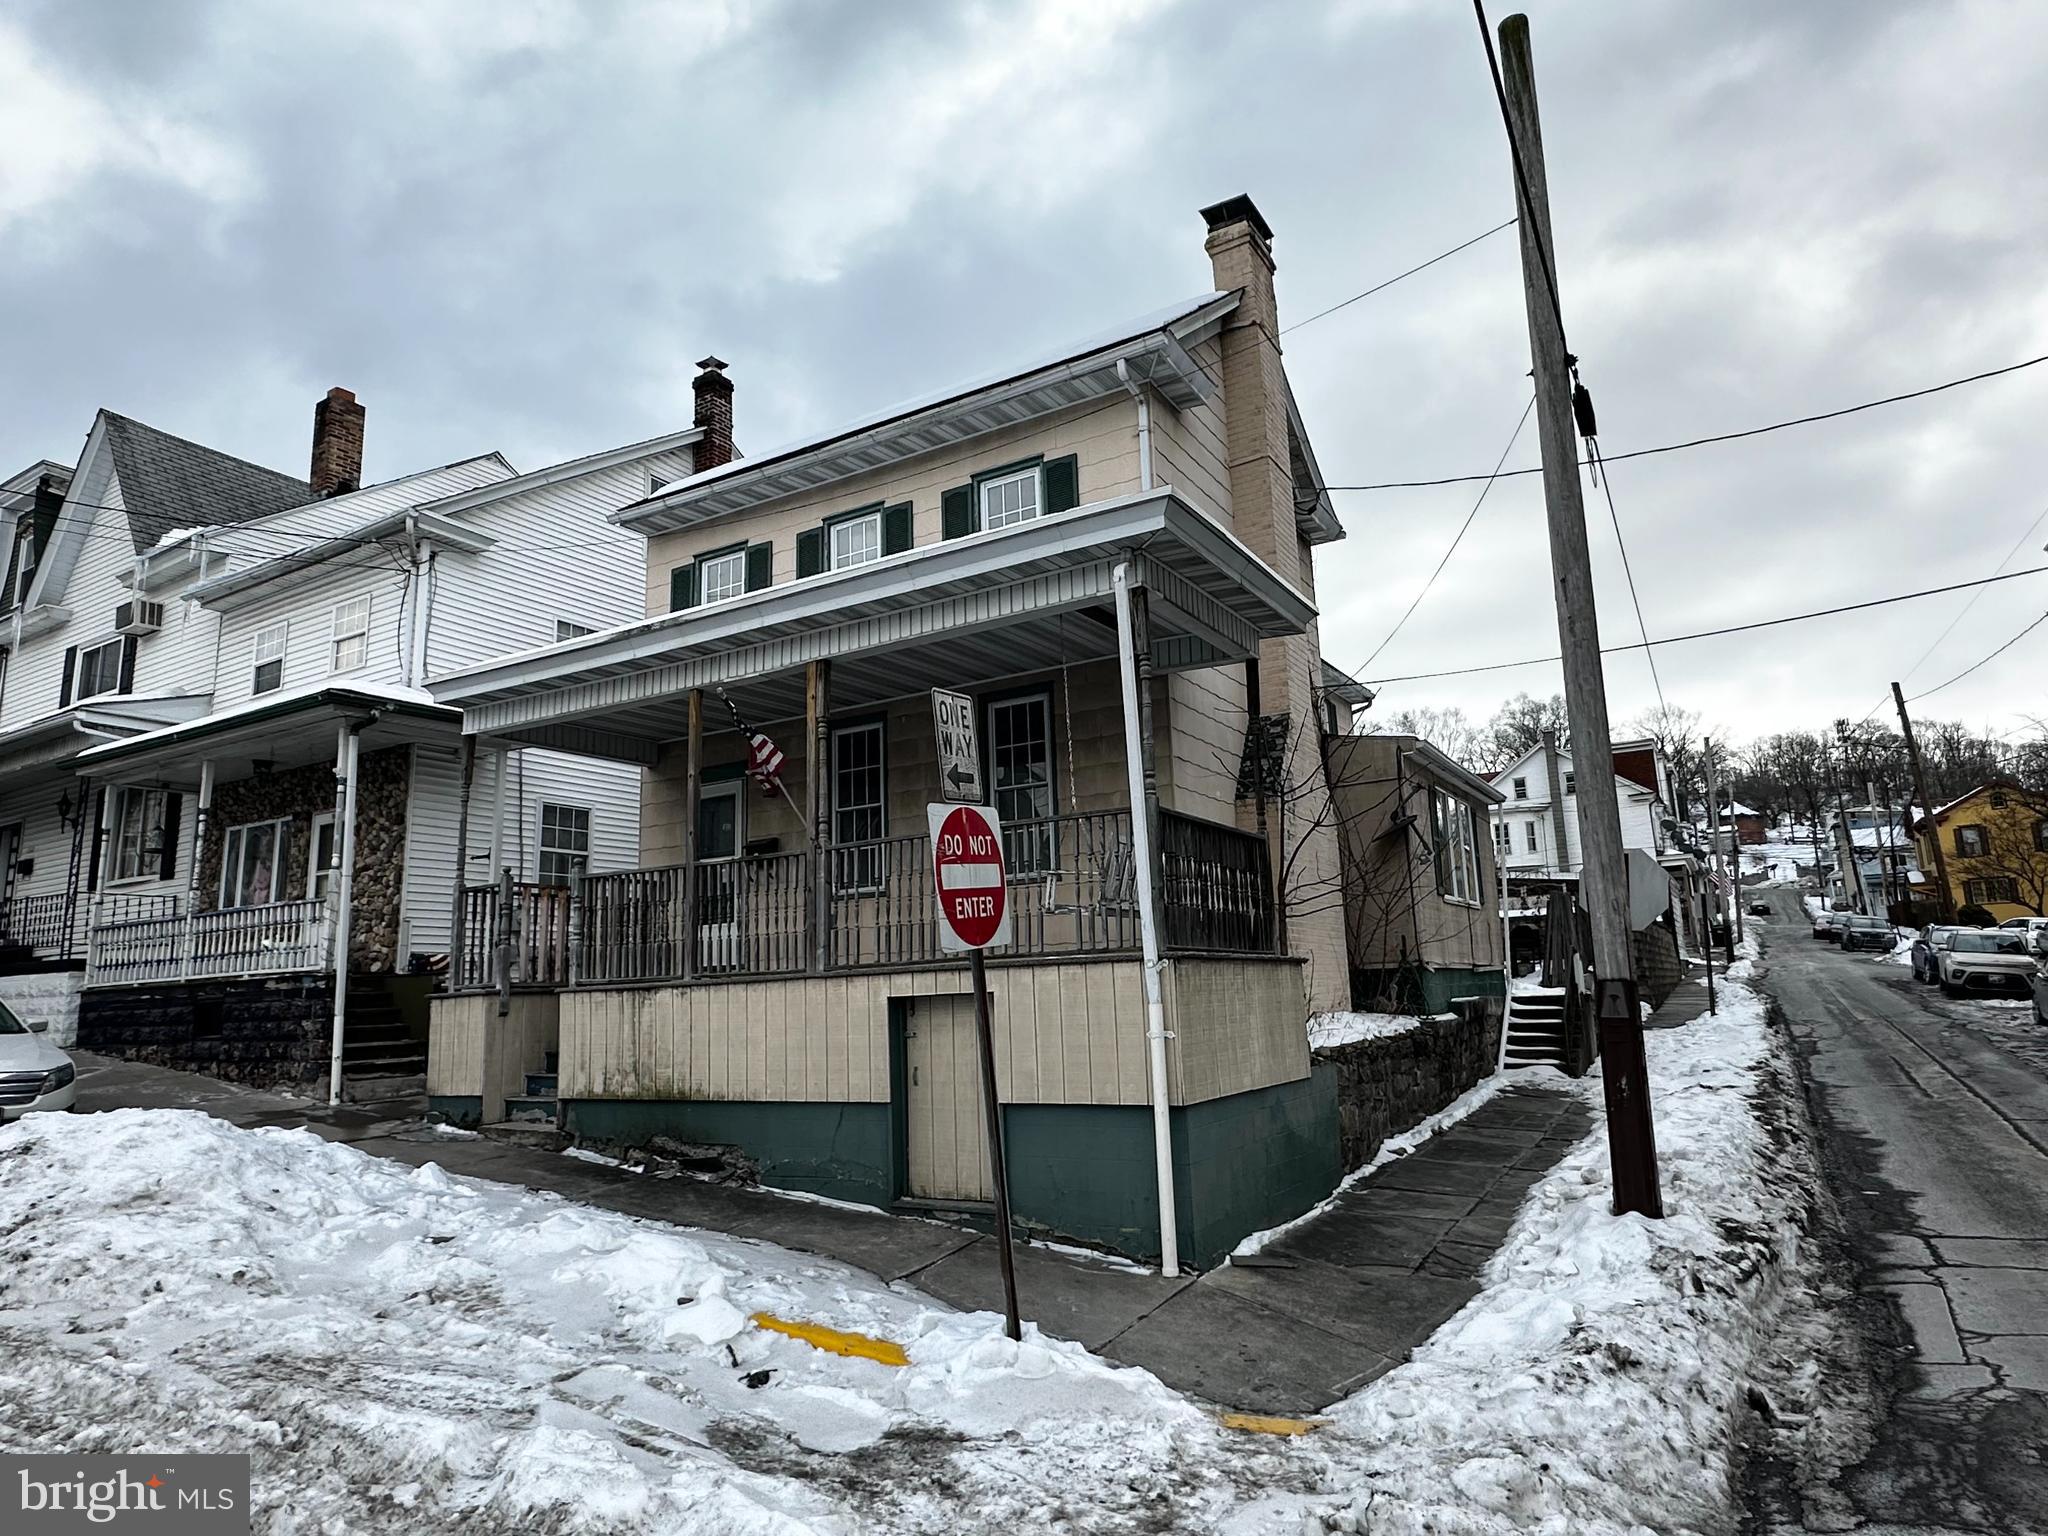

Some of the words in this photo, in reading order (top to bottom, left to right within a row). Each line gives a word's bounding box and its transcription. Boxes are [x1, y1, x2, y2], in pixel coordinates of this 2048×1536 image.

[940, 700, 970, 730] ONE
[941, 730, 972, 759] WAY
[944, 834, 963, 856] DO
[969, 835, 992, 856] NOT
[955, 896, 995, 920] ENTER
